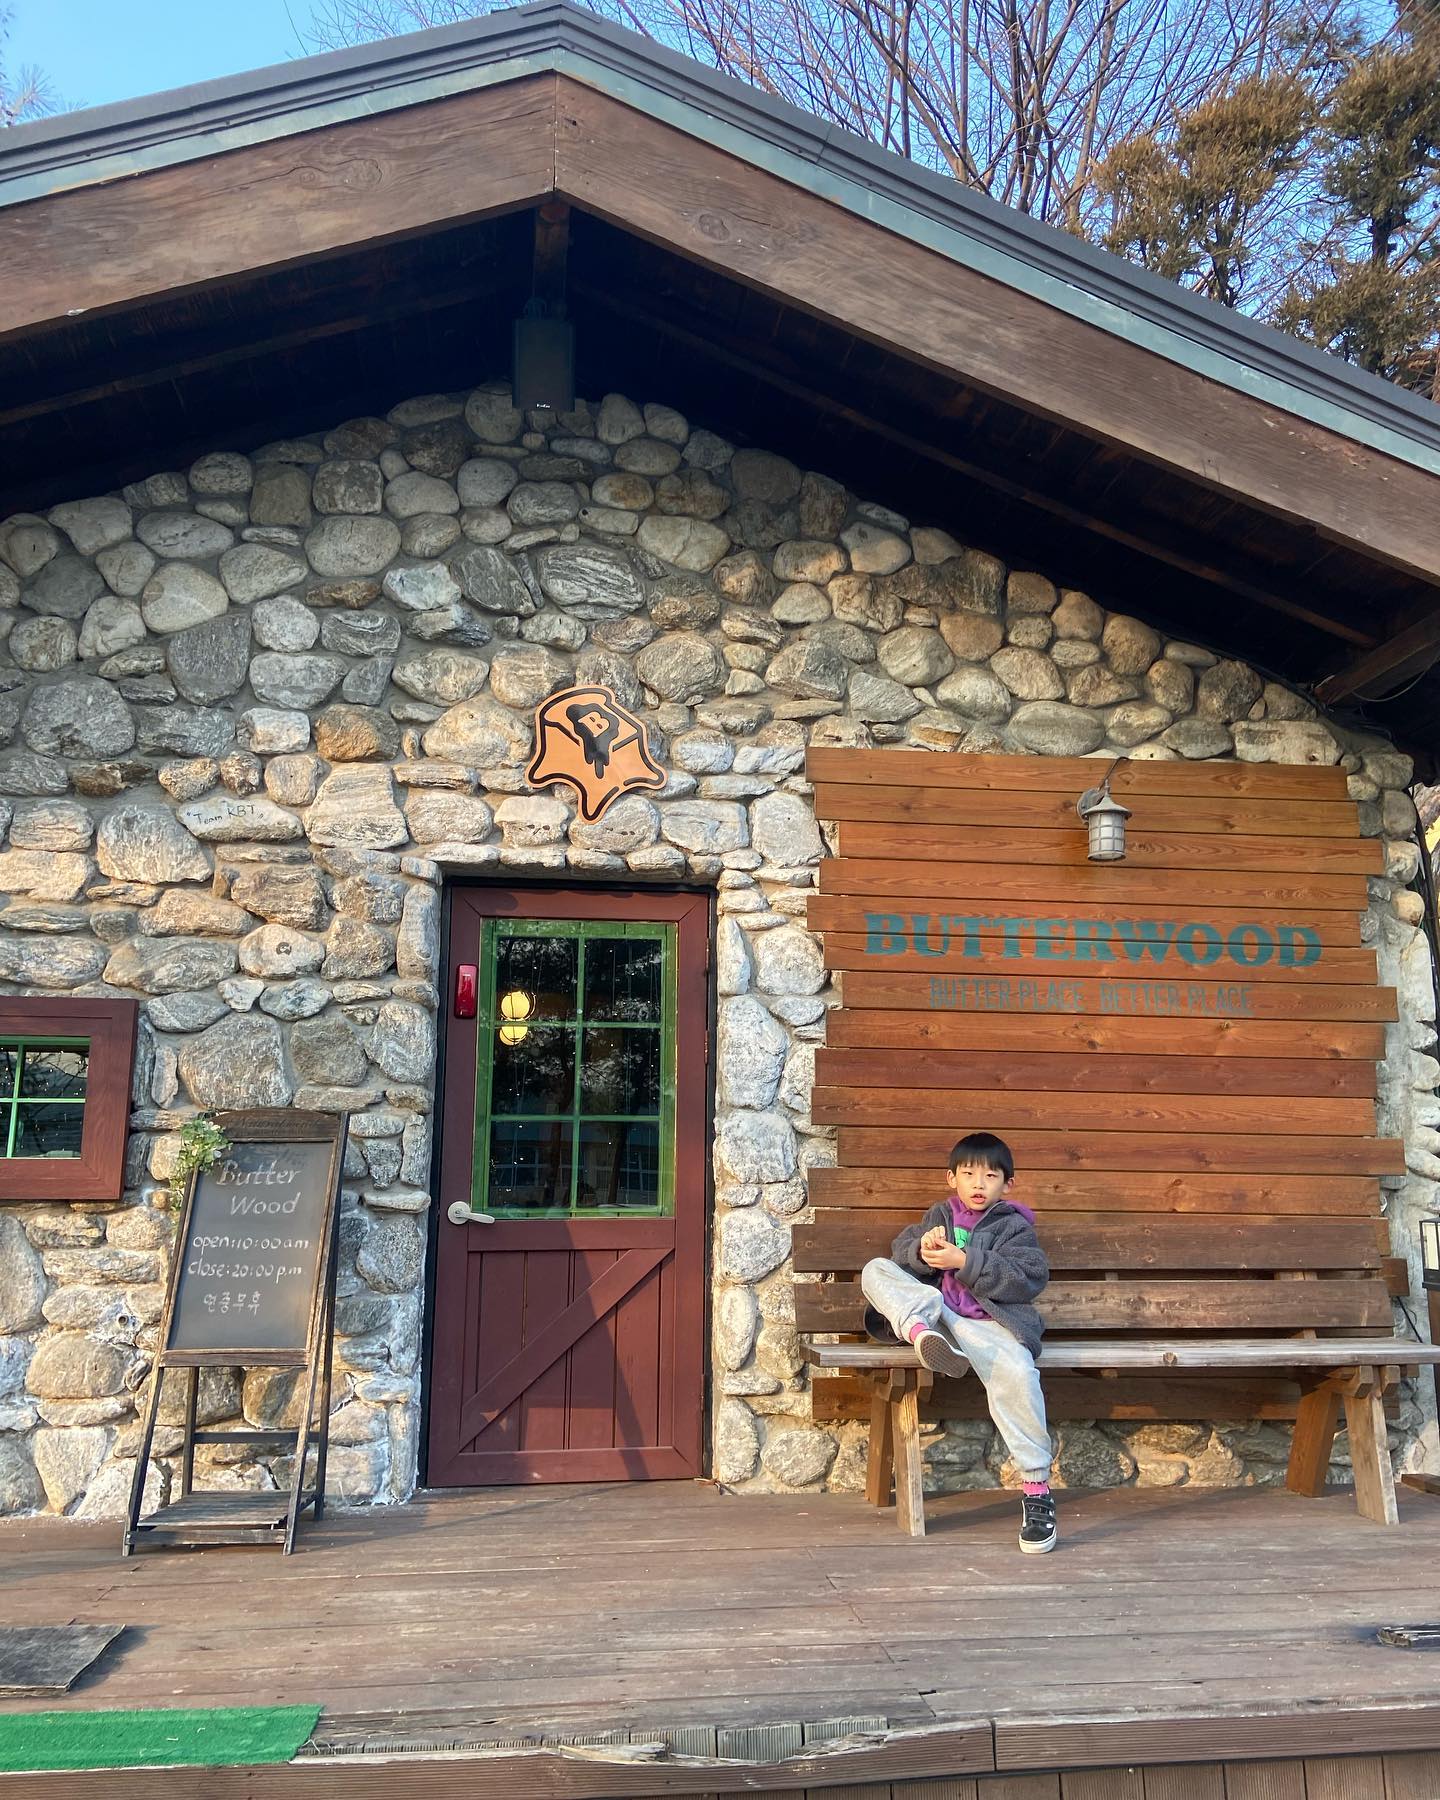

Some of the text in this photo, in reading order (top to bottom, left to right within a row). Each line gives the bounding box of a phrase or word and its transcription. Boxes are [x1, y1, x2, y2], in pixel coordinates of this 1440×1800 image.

[863, 912, 1322, 968] BUTTERWOOD
[929, 976, 1254, 1017] BUTTER PLACE BETTER PLACE
[216, 1159, 302, 1186] Butter
[230, 1191, 301, 1215] Wood
[203, 1291, 263, 1315] 연중무휴
